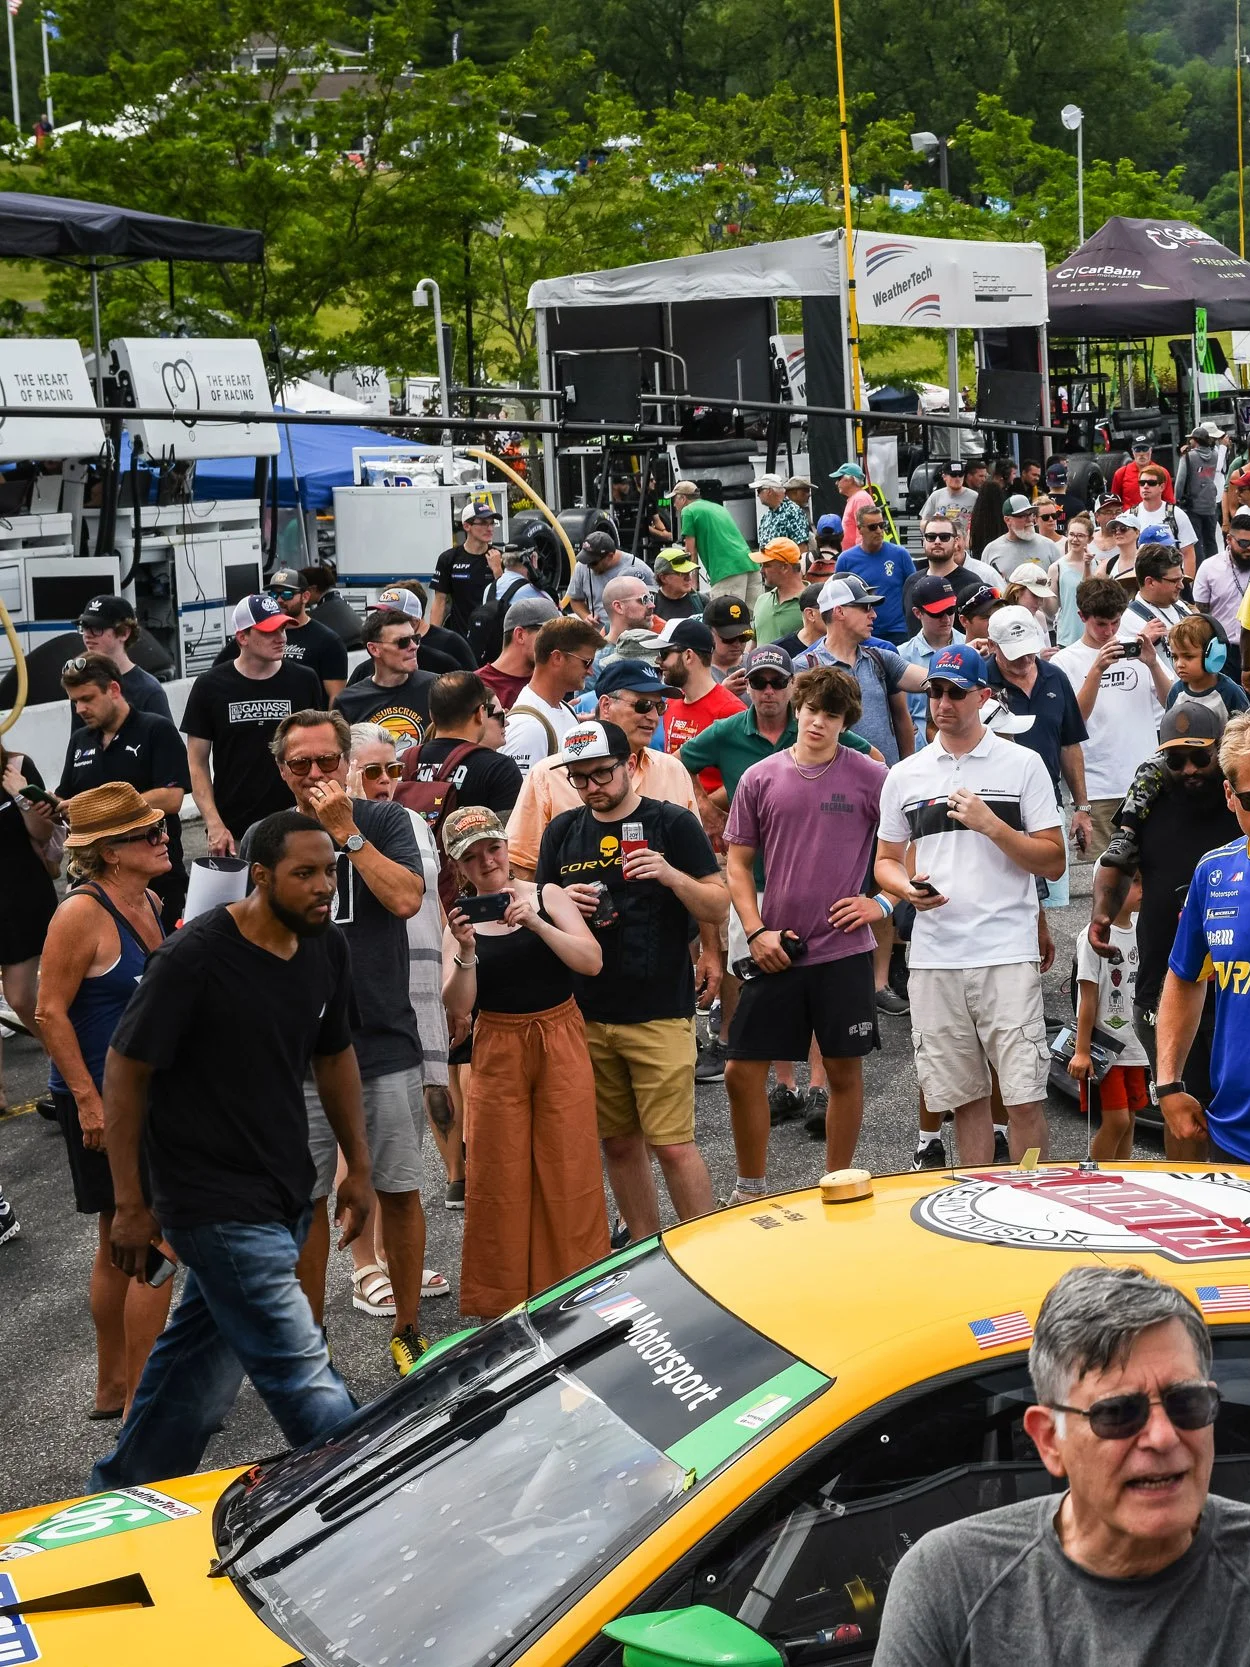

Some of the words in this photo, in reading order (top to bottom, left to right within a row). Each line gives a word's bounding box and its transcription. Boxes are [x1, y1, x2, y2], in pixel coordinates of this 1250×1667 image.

[1078, 265, 1141, 278] CarBahn
[872, 264, 933, 307] WeatherTech
[14, 374, 35, 387] THE
[37, 373, 71, 386] HEART
[206, 375, 224, 386] THE
[225, 374, 251, 387] HEART
[20, 390, 33, 402] OF
[36, 389, 73, 402] RACING
[211, 390, 221, 401] OF
[224, 389, 254, 401] RACING
[242, 702, 289, 713] GANASSI
[231, 711, 289, 720] RACING
[371, 706, 423, 724] NSUBSCRIBE
[560, 857, 623, 875] CORVE
[1210, 889, 1239, 899] Motorsport
[623, 1311, 723, 1412] Motorsport
